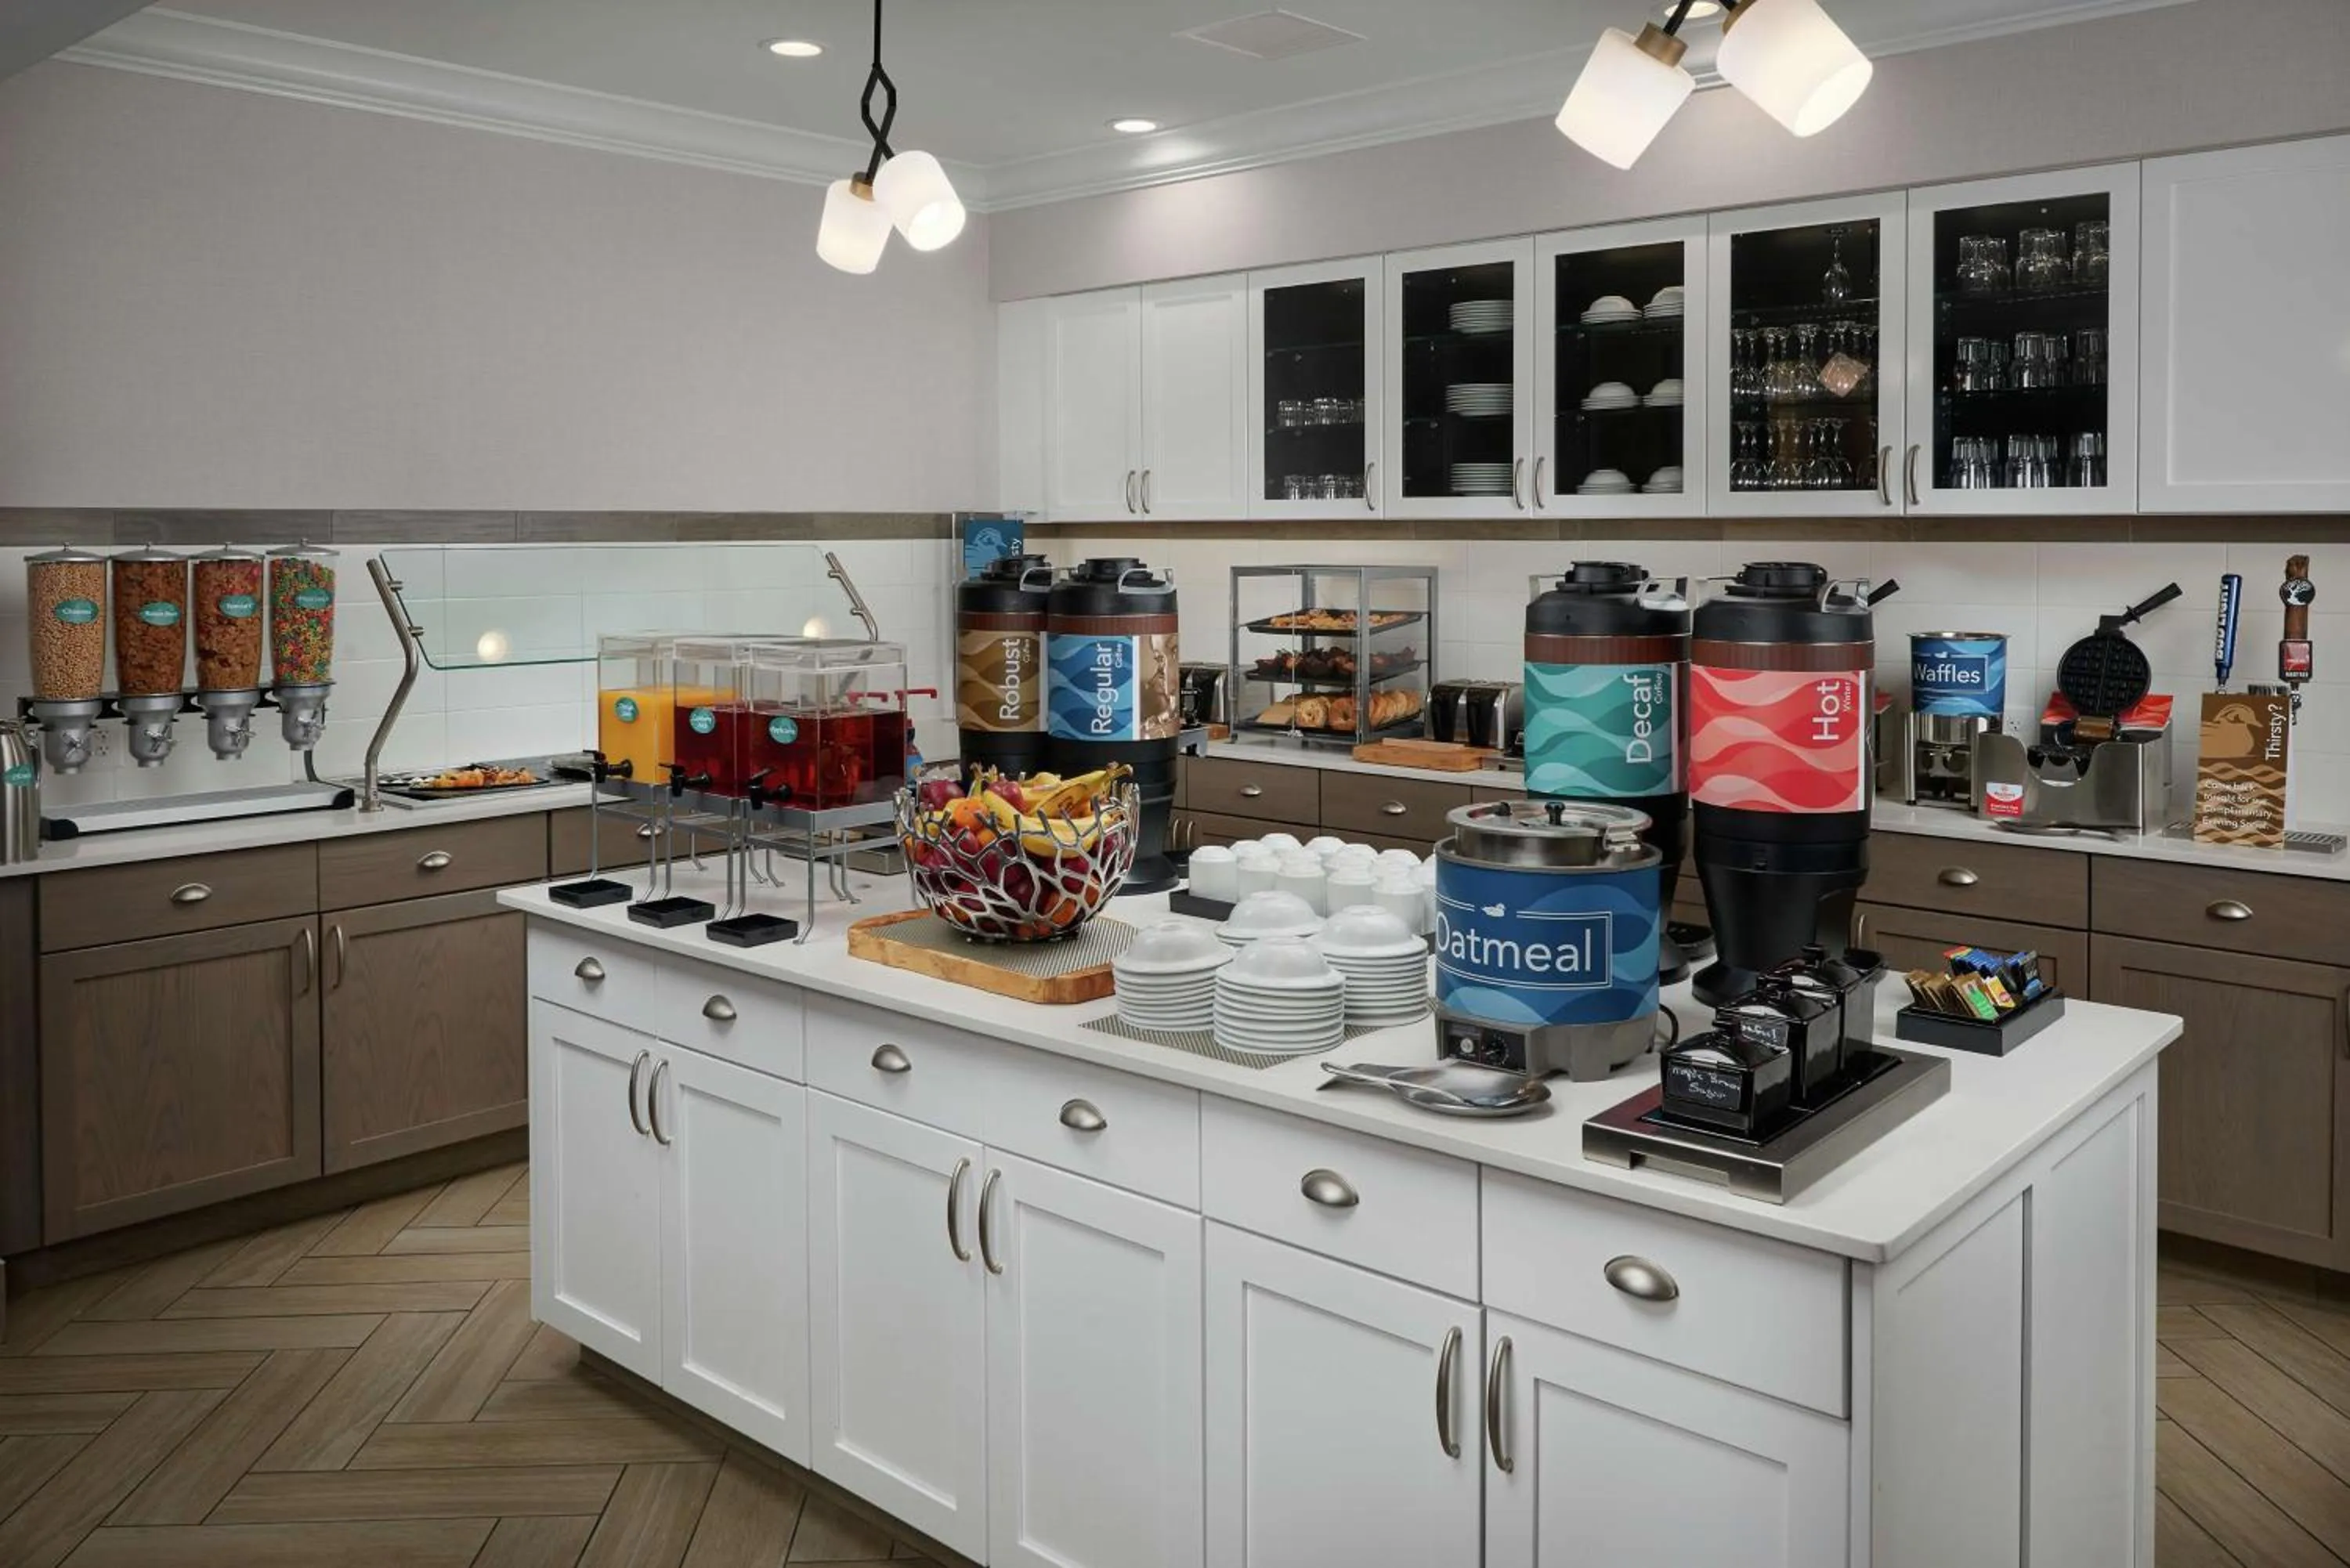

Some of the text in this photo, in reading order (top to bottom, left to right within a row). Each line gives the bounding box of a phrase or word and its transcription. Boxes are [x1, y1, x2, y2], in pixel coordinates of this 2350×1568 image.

[2215, 583, 2229, 660] BUD LIGHT
[999, 638, 1021, 720] Robust
[1090, 643, 1119, 734] Regular
[1914, 663, 1980, 684] Waffles
[1623, 674, 1651, 764] Decaf
[1812, 681, 1840, 740] Hot
[2265, 703, 2287, 761] Thirsty?
[1436, 911, 1591, 972] Oatmeal
